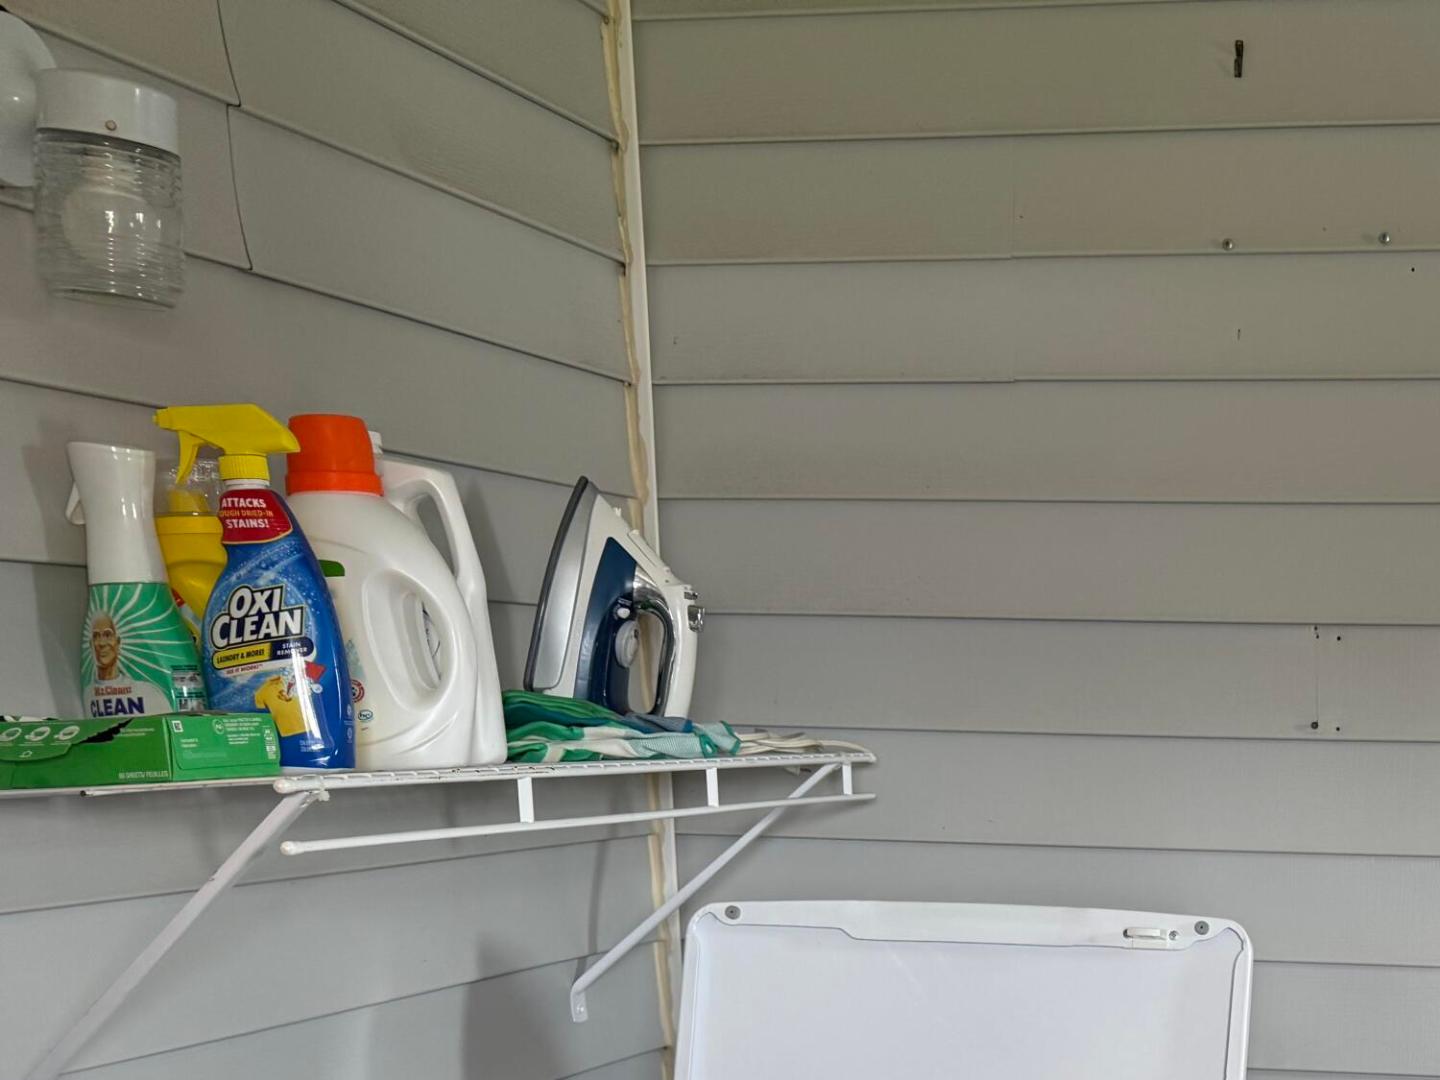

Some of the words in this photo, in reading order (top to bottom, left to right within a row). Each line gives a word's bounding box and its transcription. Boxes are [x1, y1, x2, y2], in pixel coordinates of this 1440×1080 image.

[221, 497, 267, 508] ATTACKS
[217, 510, 240, 518] OUGH
[225, 518, 270, 529] STAINS!
[229, 586, 283, 619] OXI
[211, 608, 302, 649] CLEAN
[90, 697, 144, 717] CLEAN
